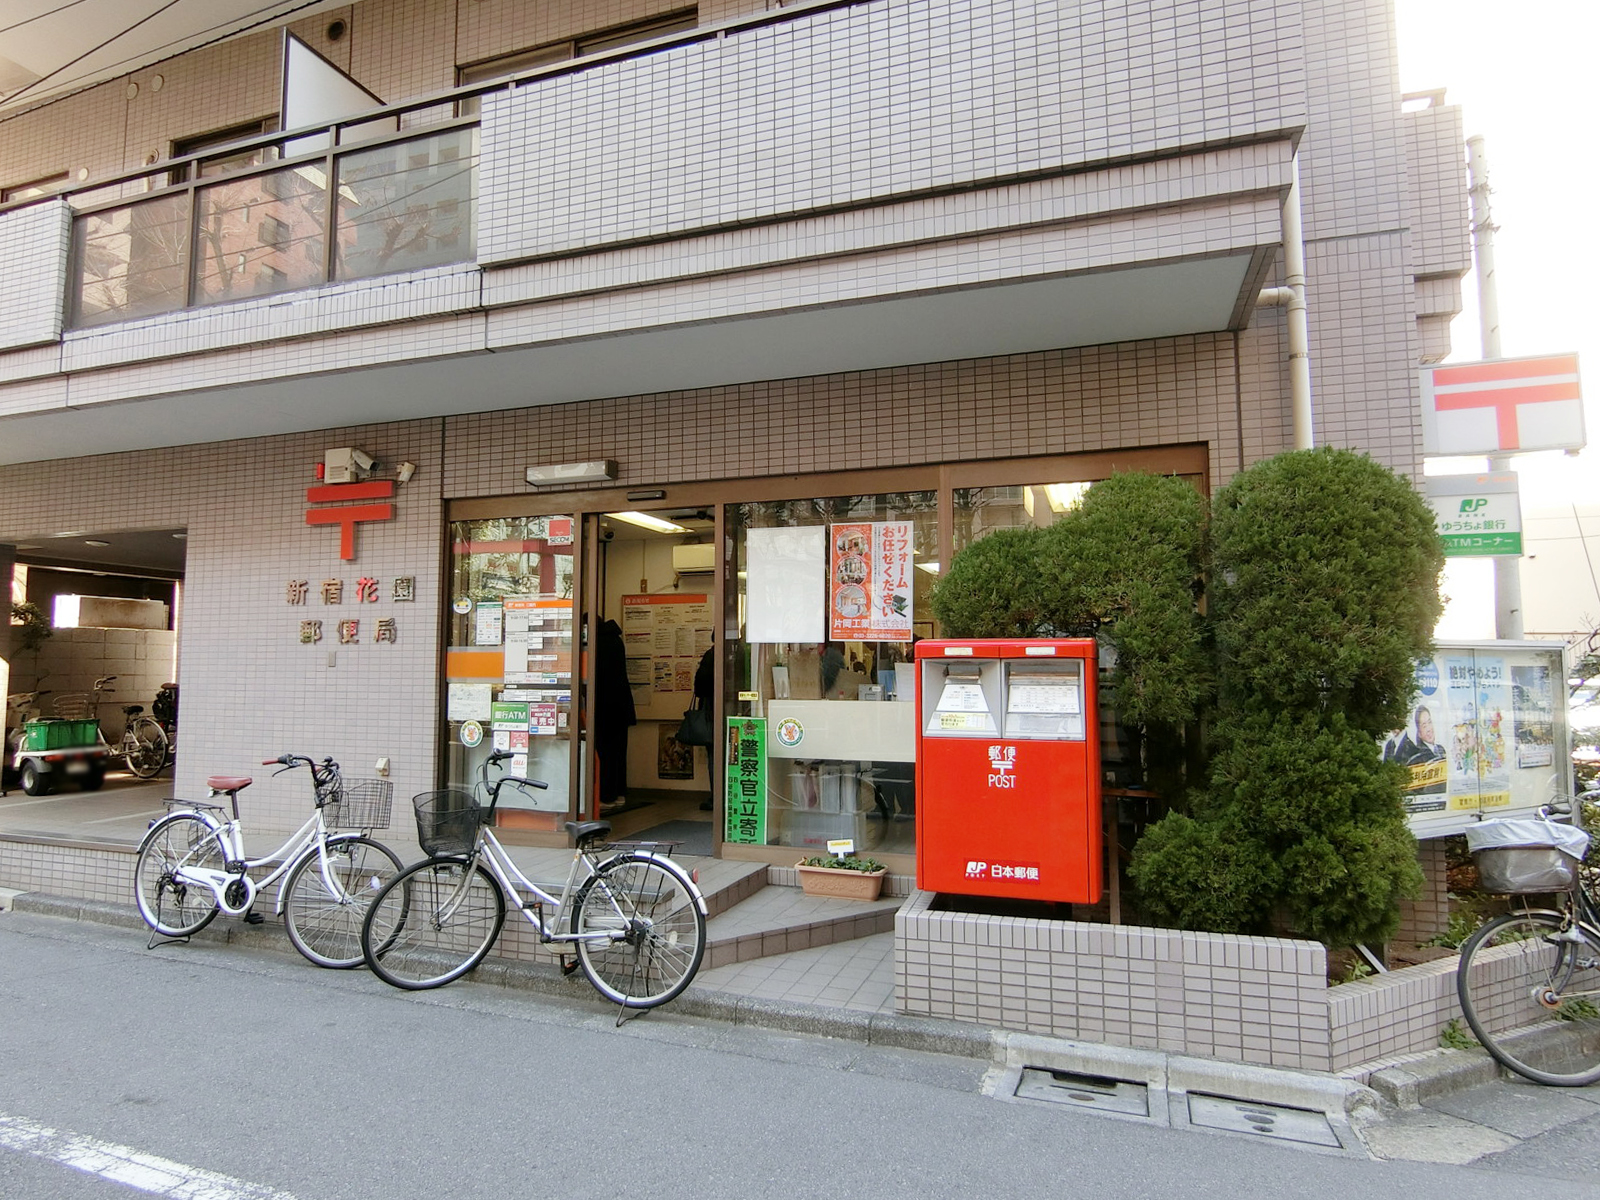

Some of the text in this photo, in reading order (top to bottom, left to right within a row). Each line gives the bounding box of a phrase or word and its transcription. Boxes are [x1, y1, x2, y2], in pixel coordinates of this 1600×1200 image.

[1441, 520, 1506, 531] ゆうちょ銀行
[896, 525, 908, 588] リフォーム
[882, 525, 895, 617] お任せください
[287, 576, 416, 606] 新宿花園
[300, 617, 398, 645] 郵便局
[987, 745, 1016, 761] 郵便
[988, 774, 1016, 788] POST
[966, 861, 987, 873] JP
[991, 864, 1039, 880] 日本郵便
